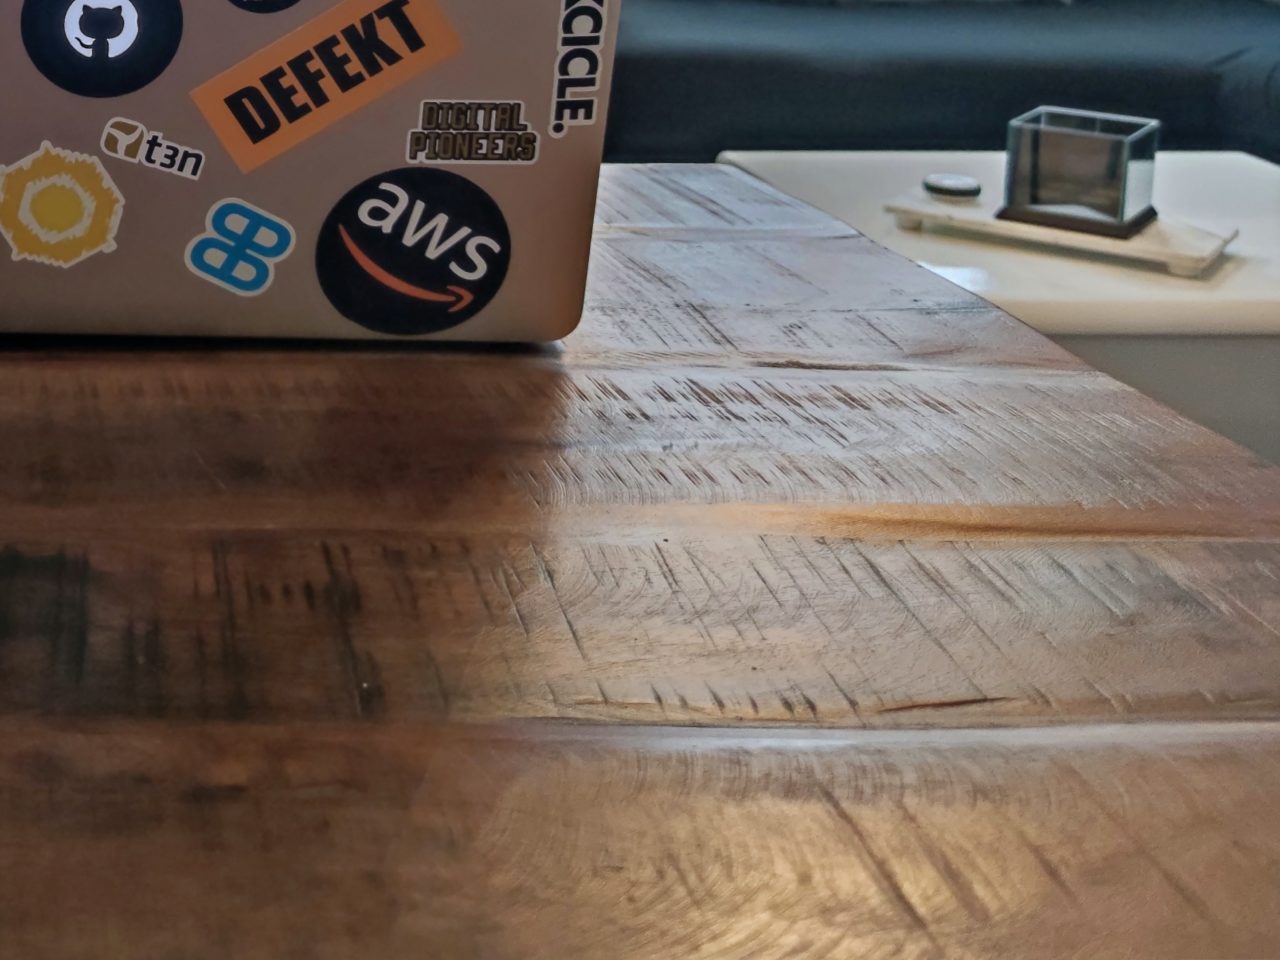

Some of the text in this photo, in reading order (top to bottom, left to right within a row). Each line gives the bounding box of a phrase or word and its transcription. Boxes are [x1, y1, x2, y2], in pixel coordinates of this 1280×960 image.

[421, 101, 528, 131] DIGITAL
[409, 131, 537, 161] PIONEERS
[357, 181, 502, 282] aws
